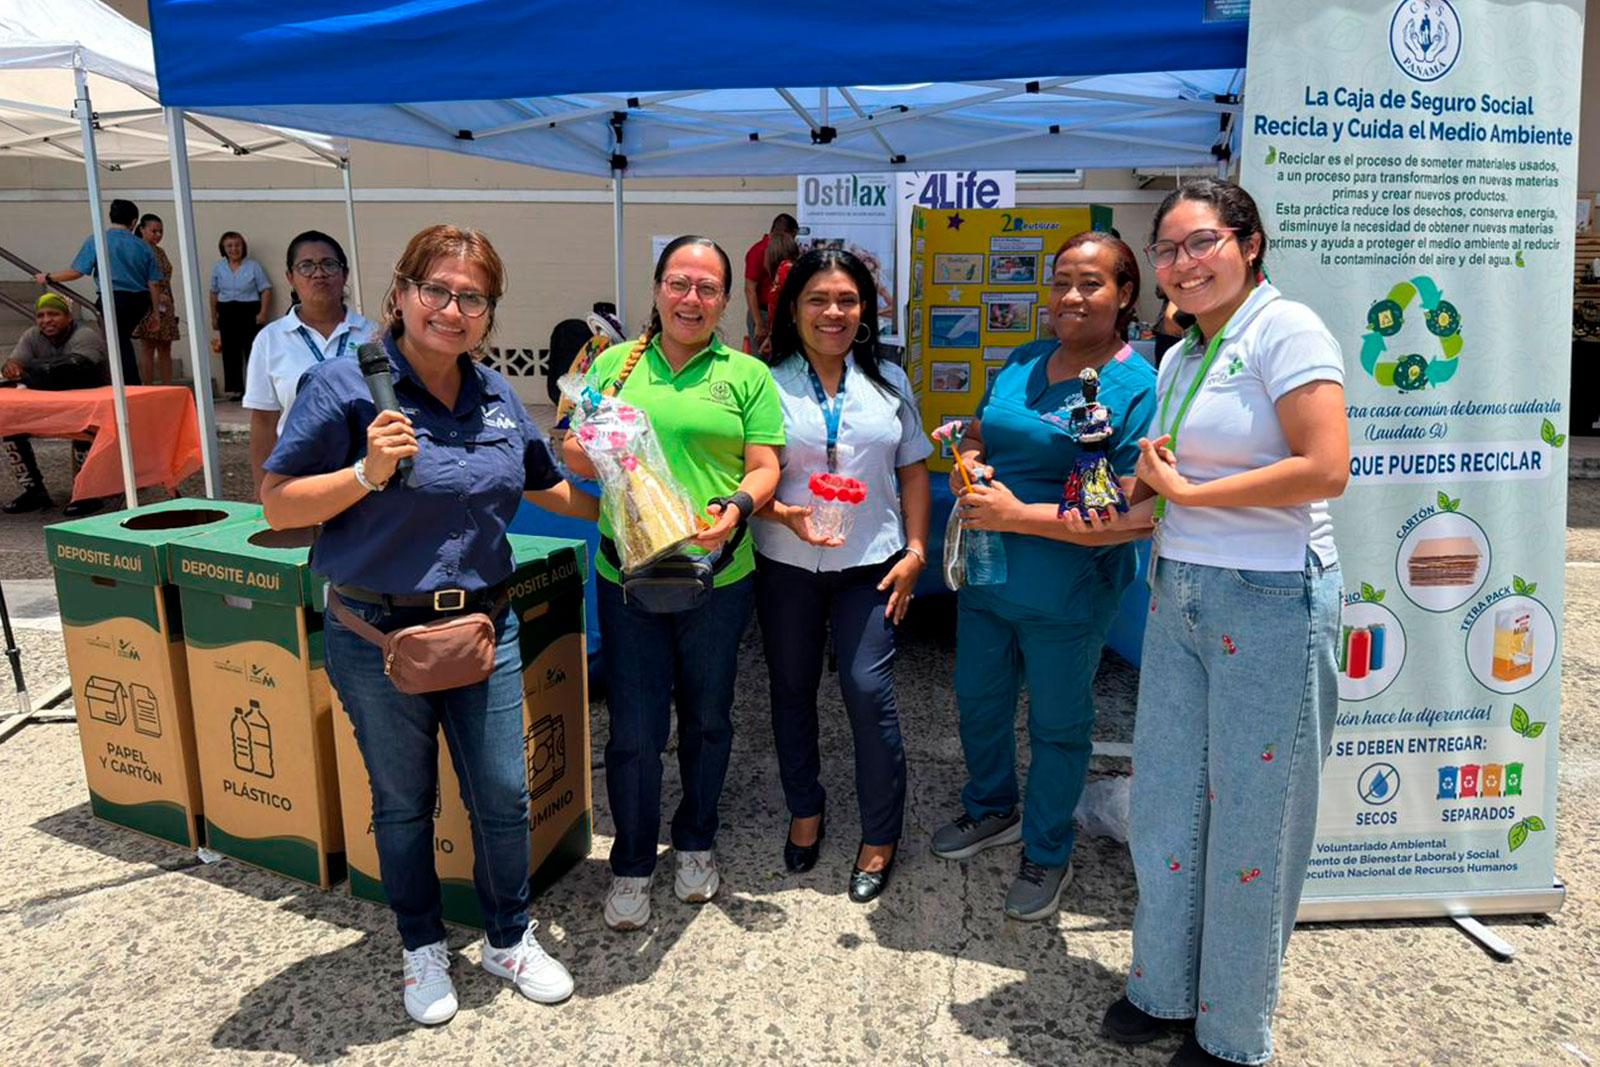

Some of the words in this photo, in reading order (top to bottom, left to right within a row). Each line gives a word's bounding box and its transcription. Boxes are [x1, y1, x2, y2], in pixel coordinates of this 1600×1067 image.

[1305, 86, 1329, 106] La
[1334, 87, 1375, 112] Caja
[1379, 88, 1406, 109] de
[1411, 90, 1476, 116] Seguro
[1480, 94, 1534, 115] Social
[1253, 115, 1329, 137] Recicla
[1333, 121, 1344, 142] y
[1348, 118, 1403, 140] Cuida
[1409, 120, 1426, 140] el
[1430, 121, 1487, 142] Medio
[1490, 126, 1573, 146] Ambiente
[1279, 152, 1325, 165] Reciclar
[1328, 156, 1341, 165] es
[1344, 154, 1354, 165] el
[1356, 155, 1402, 168] proceso
[1404, 154, 1418, 166] de
[1421, 157, 1463, 169] someter
[1466, 158, 1516, 170] materiales
[1519, 159, 1559, 172] usados,
[1277, 172, 1284, 181] a
[1287, 172, 1301, 181] un
[1304, 171, 1350, 184] proceso
[1353, 173, 1377, 184] para
[1380, 172, 1459, 185] transformarlos
[1462, 175, 1476, 185] en
[1479, 175, 1512, 186] nuevas
[1515, 175, 1559, 187] materias
[805, 174, 887, 206] Ostilax
[919, 171, 1000, 209] 4Life
[1332, 187, 1369, 200] primas
[1372, 190, 1379, 202] y
[1381, 189, 1412, 200] crear
[1414, 190, 1451, 200] nuevos
[1454, 189, 1508, 203] productos.
[1276, 202, 1300, 215] Esta
[1303, 203, 1349, 217] práctica
[1352, 203, 1389, 216] reduce
[1392, 204, 1410, 216] los
[1413, 205, 1467, 218] desechos,
[1469, 207, 1514, 218] conserva
[1279, 220, 1338, 235] disminuye
[1341, 221, 1350, 232] la
[1353, 221, 1411, 232] necesidad
[1414, 221, 1426, 232] de
[1428, 222, 1470, 233] obtener
[1473, 223, 1507, 234] nuevas
[1509, 223, 1554, 234] materias
[1269, 237, 1308, 250] primas
[1310, 239, 1318, 251] y
[1321, 237, 1355, 250] ayuda
[1357, 239, 1363, 248] a
[1366, 238, 1415, 251] proteger
[1418, 238, 1427, 249] el
[1429, 238, 1461, 249] medio
[1464, 238, 1510, 249] ambiente
[1512, 238, 1522, 250] al
[1524, 239, 1560, 250] reducir
[1321, 253, 1331, 265] la
[1334, 253, 1416, 265] contaminación
[1419, 254, 1433, 265] del
[1436, 254, 1455, 265] aire
[1458, 256, 1466, 267] y
[1469, 254, 1485, 265] del
[1488, 256, 1513, 268] agua.
[1370, 405, 1401, 418] casa
[1404, 402, 1450, 417] común
[1450, 400, 1507, 417] debemos
[1509, 398, 1561, 414] cuidarla
[1364, 423, 1427, 441] (Laudato
[1350, 455, 1384, 476] QUE
[1388, 453, 1456, 475] PUEDES
[1460, 451, 1542, 473] RECICLAR
[1396, 505, 1436, 539] CARTÓN
[57, 544, 111, 567] DEPOSITE
[181, 559, 243, 584] DEPOSITE
[507, 572, 550, 600] POSITE
[1460, 601, 1487, 632] TETRA
[1485, 585, 1512, 605] PACK
[1361, 710, 1396, 725] hace
[1399, 708, 1413, 723] la
[1416, 705, 1492, 727] diferencia!
[107, 742, 148, 765] PAPEL
[1336, 742, 1354, 756] SE
[1357, 739, 1404, 755] DEBEN
[1408, 735, 1488, 753] ENTREGAR:
[99, 756, 110, 771] Y
[110, 758, 163, 785] CARTÓN
[223, 778, 293, 812] PLÁSTICO
[528, 790, 574, 832] UMINIO
[1356, 811, 1398, 825] SECOS
[1441, 806, 1515, 822] SEPARADOS
[1316, 842, 1388, 853] Voluntariado
[1390, 838, 1447, 850] Ambiental
[1343, 855, 1357, 865] de
[1360, 853, 1412, 864] Bienestar
[1414, 850, 1457, 862] Laboral
[1457, 853, 1465, 862] y
[1466, 849, 1500, 860] Social
[1347, 865, 1396, 877] Nacional
[1398, 866, 1413, 875] de
[1414, 864, 1465, 875] Recursos
[1467, 862, 1518, 872] Humanos
